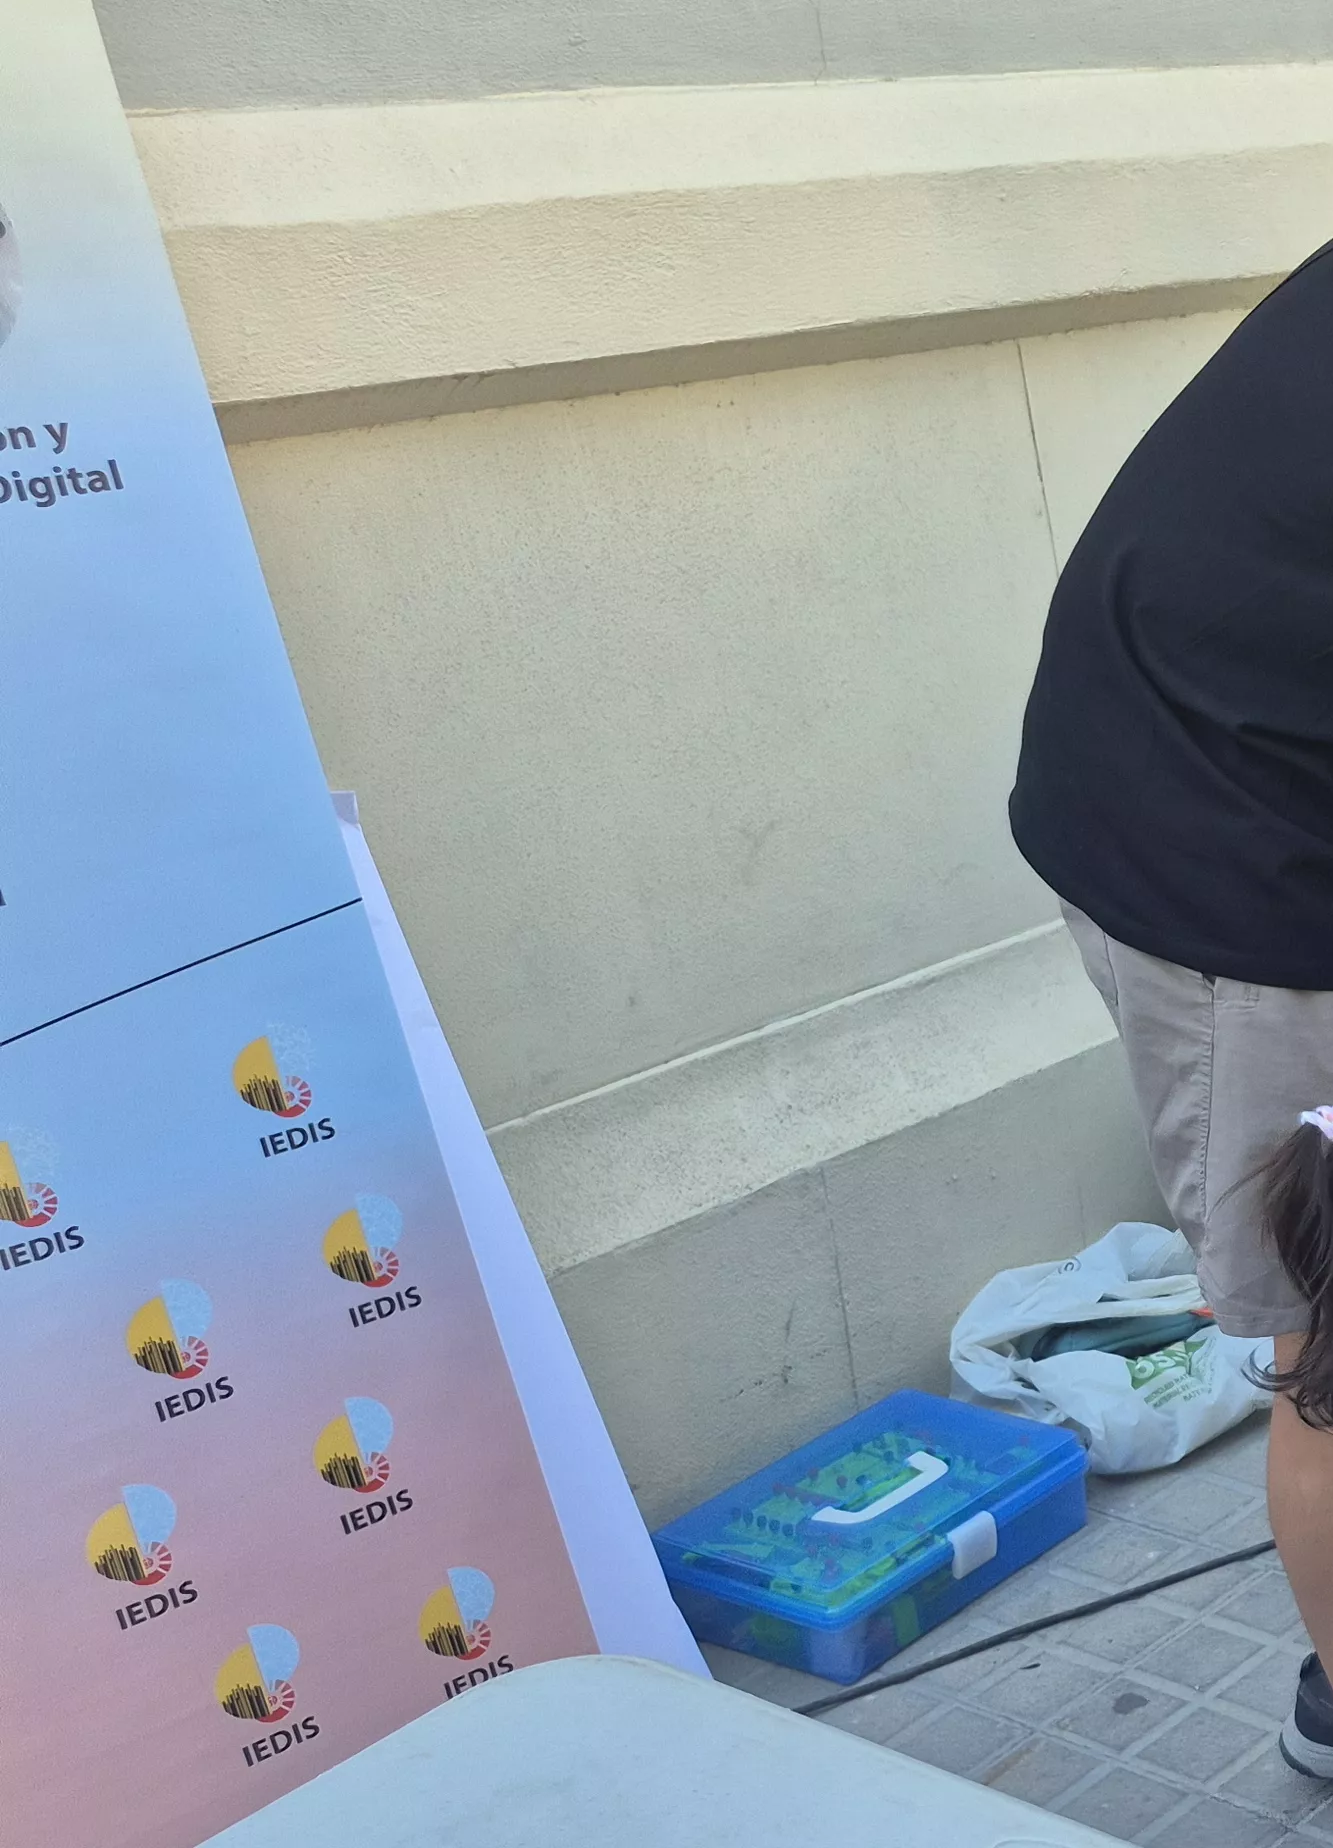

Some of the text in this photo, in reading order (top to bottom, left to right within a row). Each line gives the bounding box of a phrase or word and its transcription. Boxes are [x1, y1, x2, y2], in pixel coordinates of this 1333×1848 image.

[43, 422, 68, 455] y
[259, 1117, 336, 1158] IEDIS
[0, 1225, 85, 1271] IEDIS
[348, 1285, 423, 1328] IEDIS
[154, 1376, 235, 1422] IEDIS
[340, 1488, 414, 1535] IEDIS
[115, 1579, 199, 1631] IEDIS
[443, 1655, 514, 1700] IEDIS
[241, 1715, 321, 1767] IEDIS
